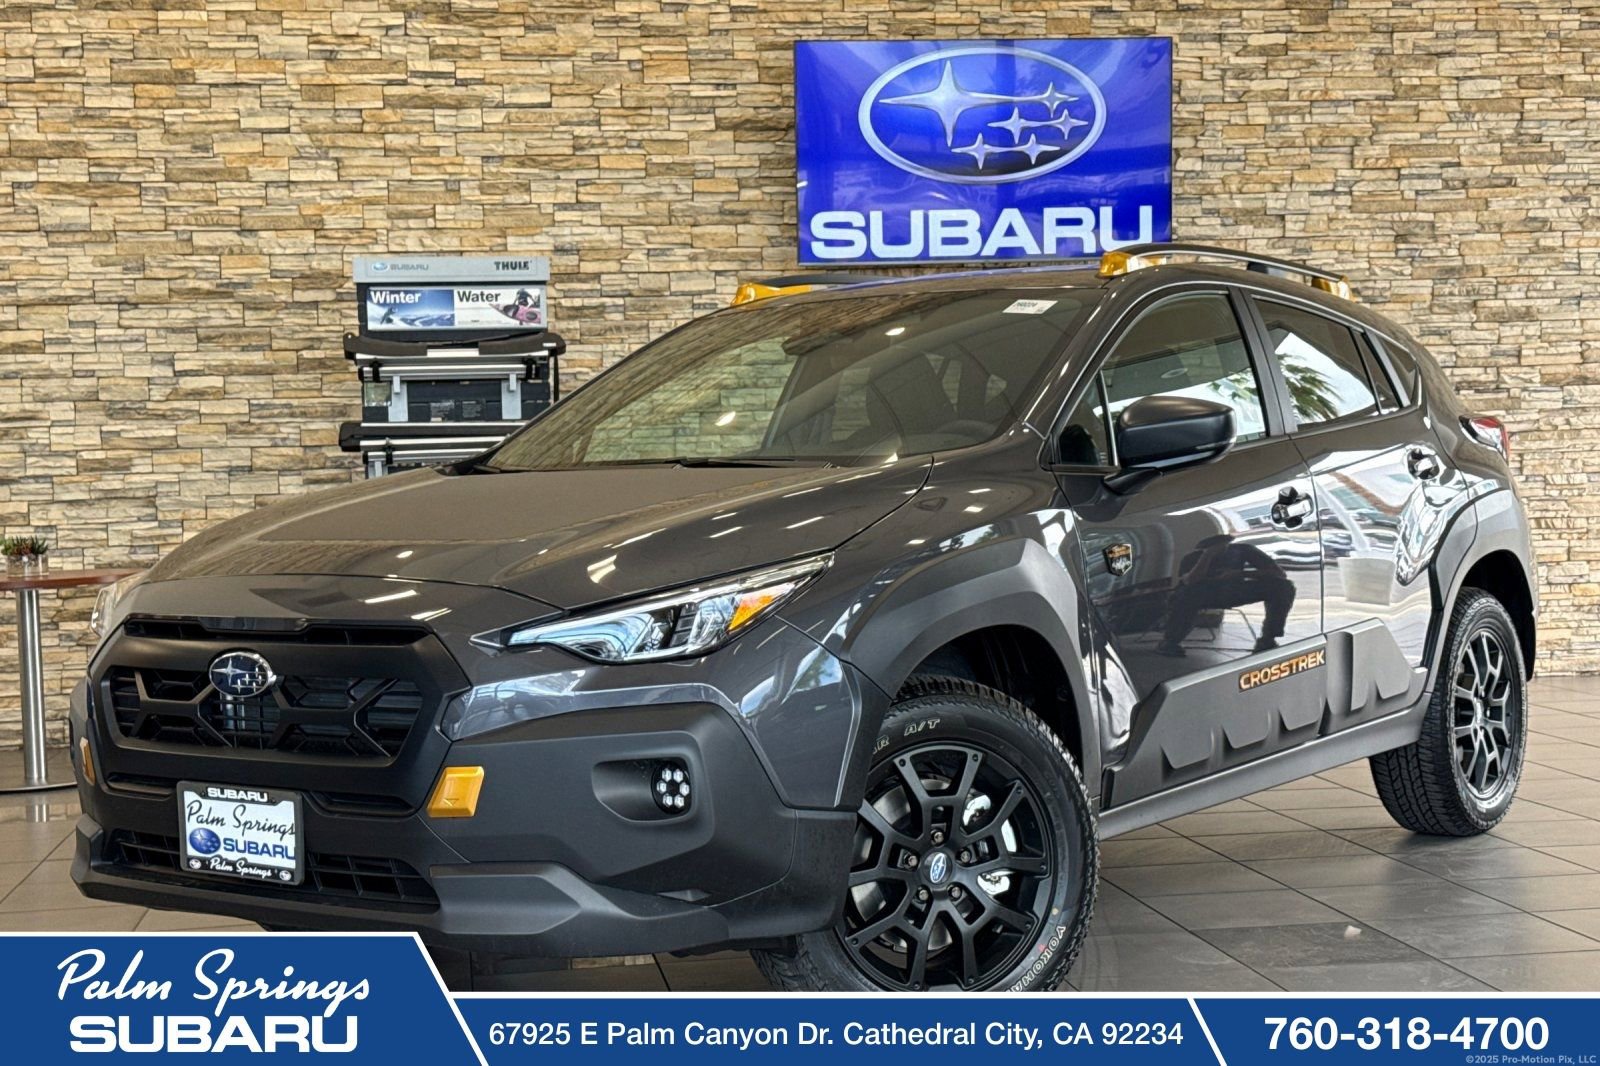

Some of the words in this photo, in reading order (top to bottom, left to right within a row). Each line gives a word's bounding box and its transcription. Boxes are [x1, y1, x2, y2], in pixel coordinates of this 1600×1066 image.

[810, 205, 1153, 258] SUBARU
[390, 263, 429, 271] SUBARU
[494, 261, 530, 271] THULE
[370, 291, 421, 304] Winter
[457, 291, 501, 303] Water
[1239, 649, 1326, 690] CROSSTREK
[207, 787, 269, 803] SUBARU
[187, 799, 226, 827] Palm
[233, 804, 296, 842] Springs
[210, 857, 234, 872] Palm
[236, 861, 273, 879] Springs
[1005, 925, 1067, 993] YOKOHA
